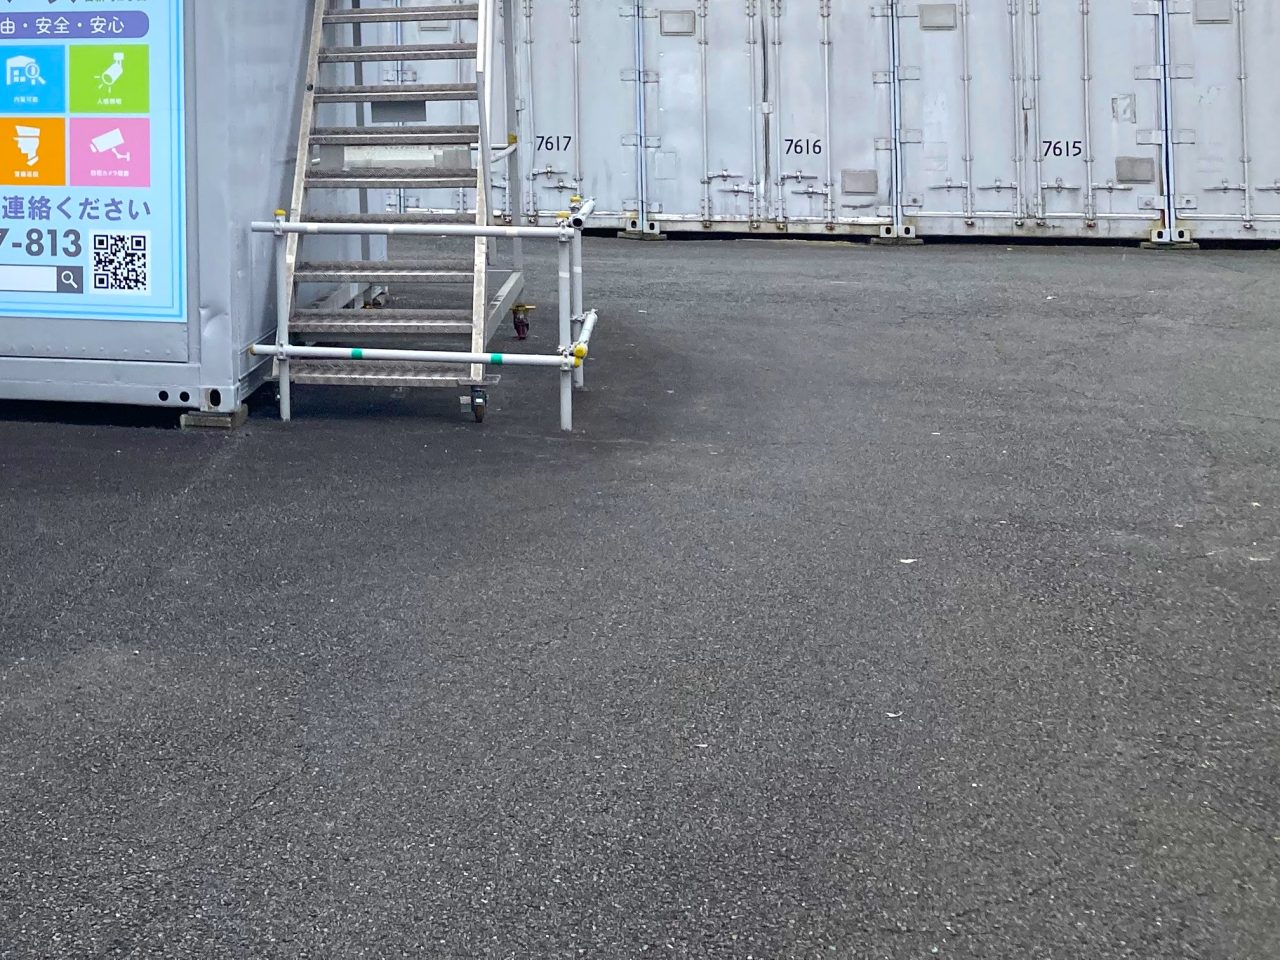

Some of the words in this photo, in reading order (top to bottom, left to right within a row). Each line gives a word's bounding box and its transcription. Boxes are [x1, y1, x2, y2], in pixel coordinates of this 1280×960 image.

[536, 135, 572, 151] 7617
[784, 138, 822, 155] 7616
[1042, 140, 1082, 157] 7615
